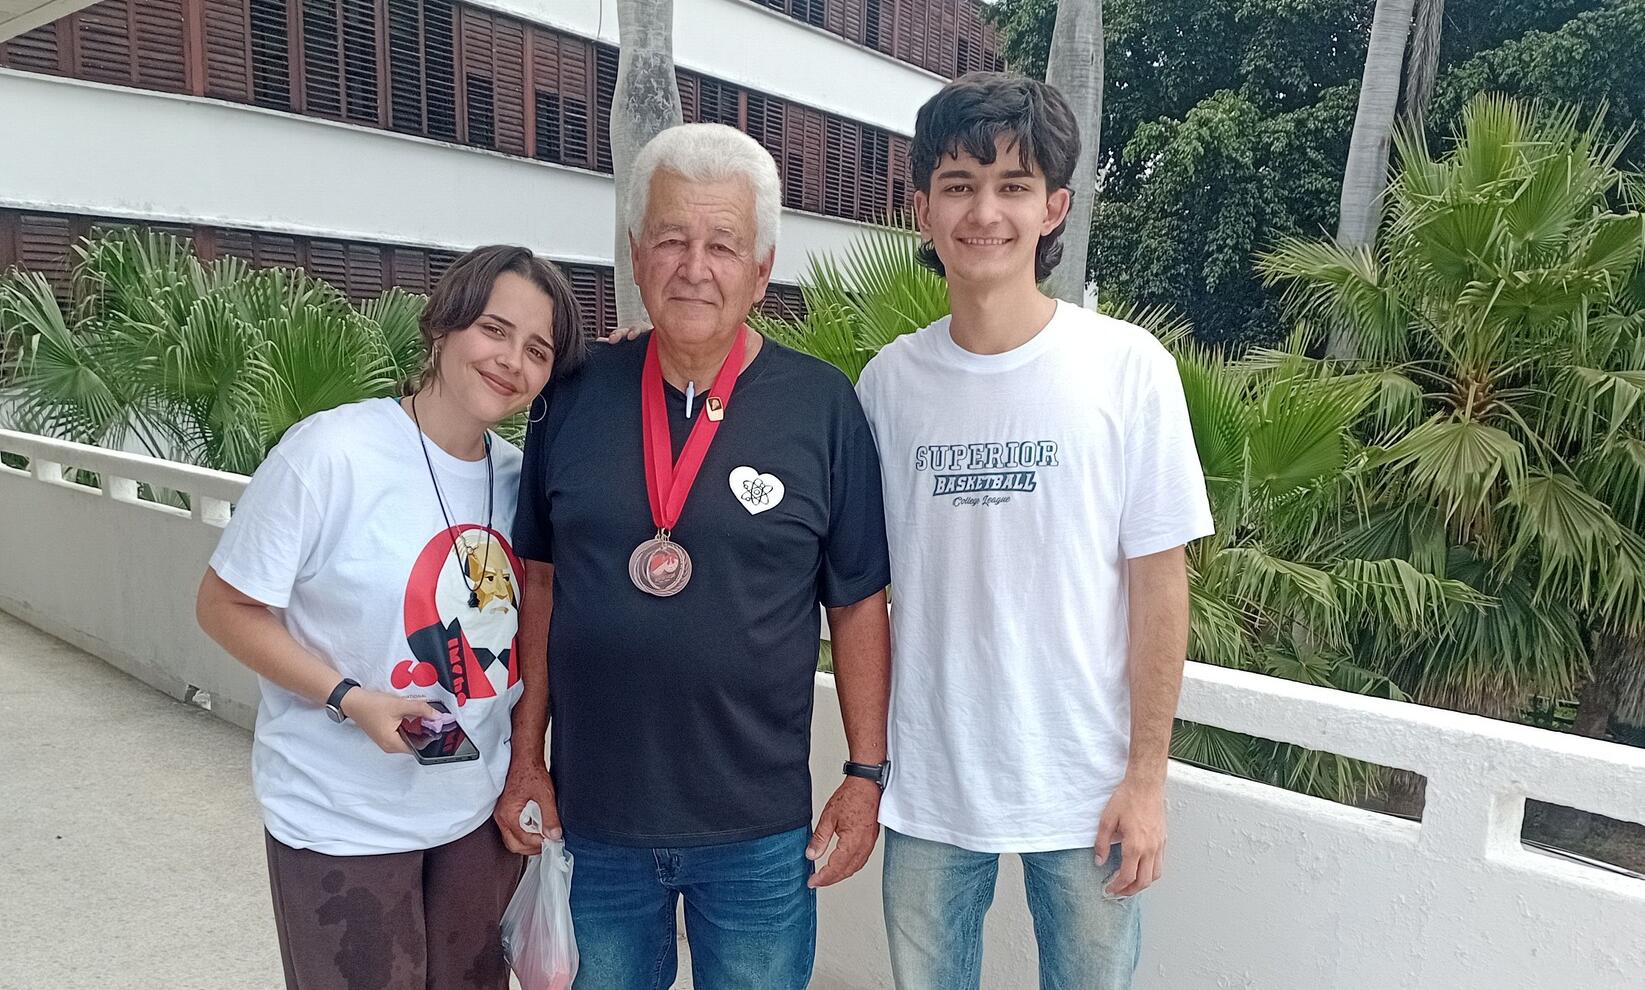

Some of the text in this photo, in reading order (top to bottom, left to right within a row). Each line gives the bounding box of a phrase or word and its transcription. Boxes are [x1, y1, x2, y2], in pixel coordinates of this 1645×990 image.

[915, 441, 1059, 471] SUPERIOR
[935, 472, 1036, 494] BASKETBALL
[952, 495, 1011, 507] College League
